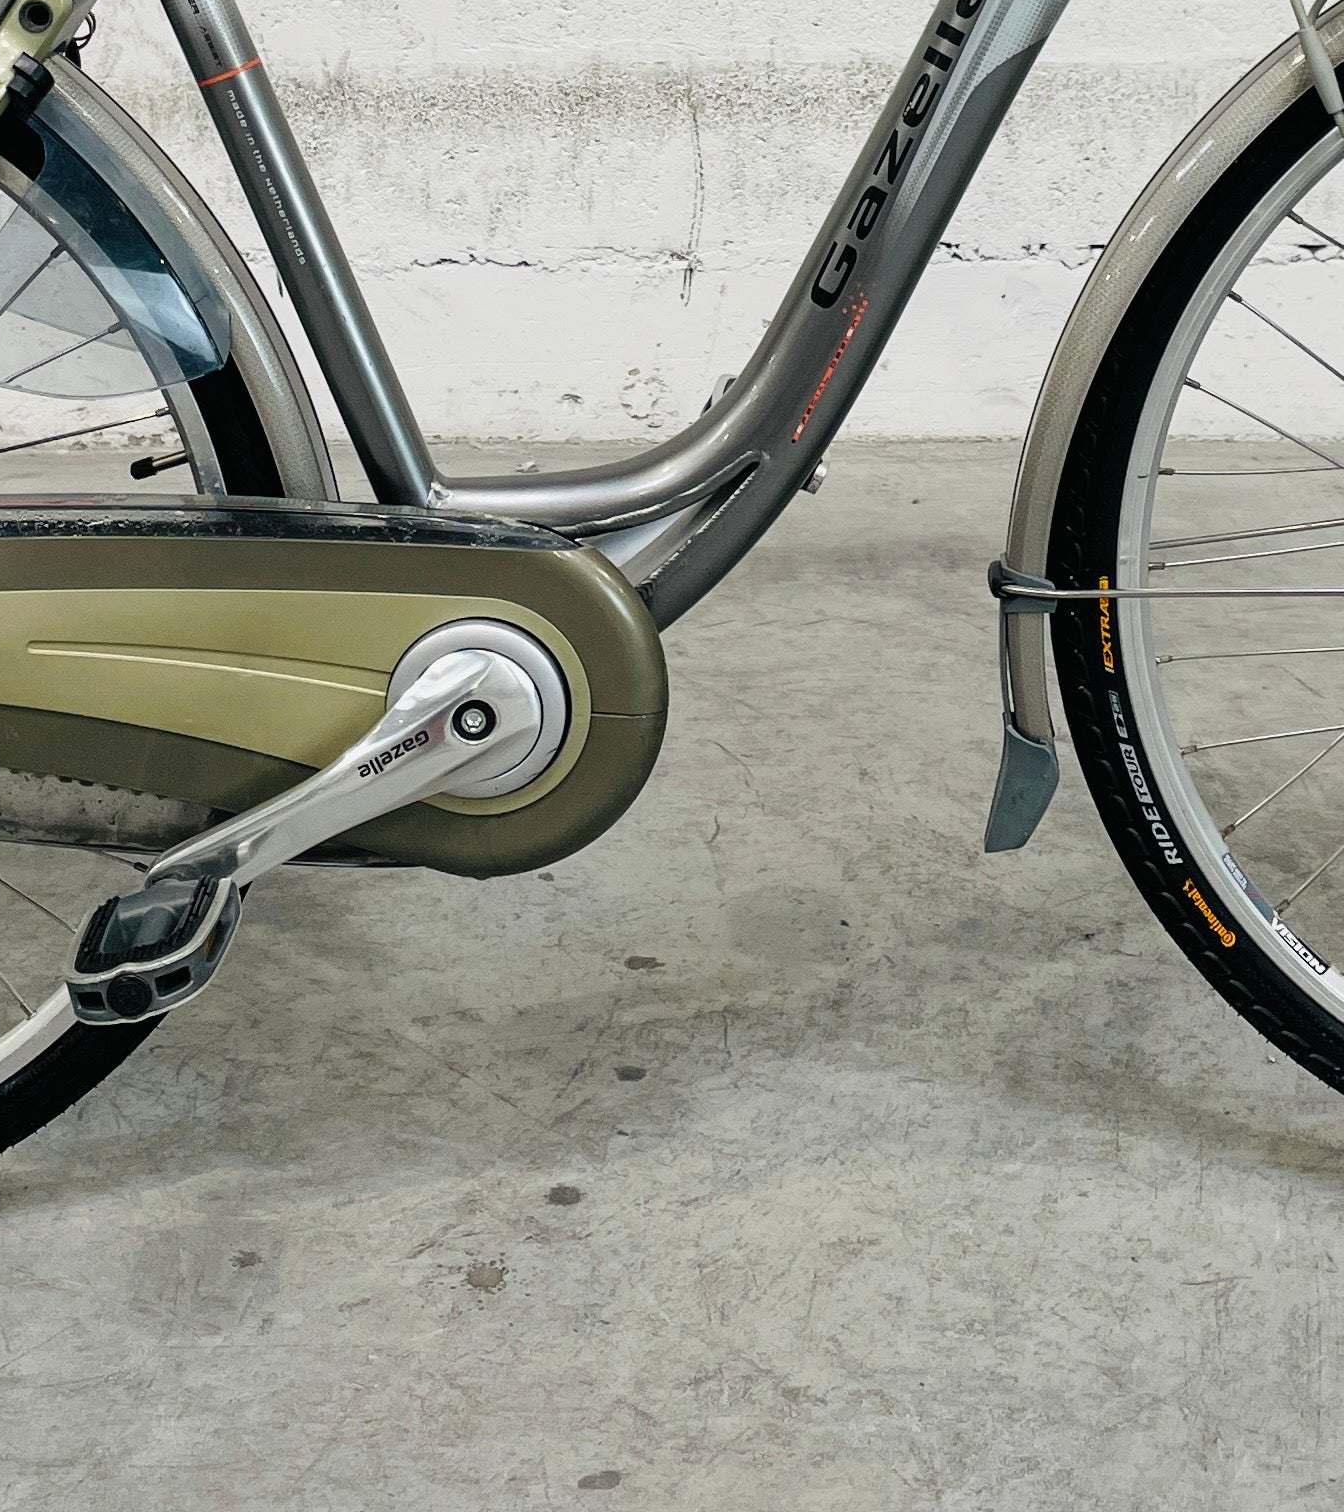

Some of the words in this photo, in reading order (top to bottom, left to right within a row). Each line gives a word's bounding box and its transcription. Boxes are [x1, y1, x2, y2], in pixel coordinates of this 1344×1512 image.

[226, 89, 247, 127] made
[251, 149, 268, 173] the
[1100, 602, 1114, 668] EXTRA
[358, 730, 429, 778] Gazelle
[1124, 747, 1151, 800] TOUR
[1142, 805, 1184, 865] RIDE
[1186, 887, 1236, 947] Continental
[1271, 917, 1326, 974] VISION
